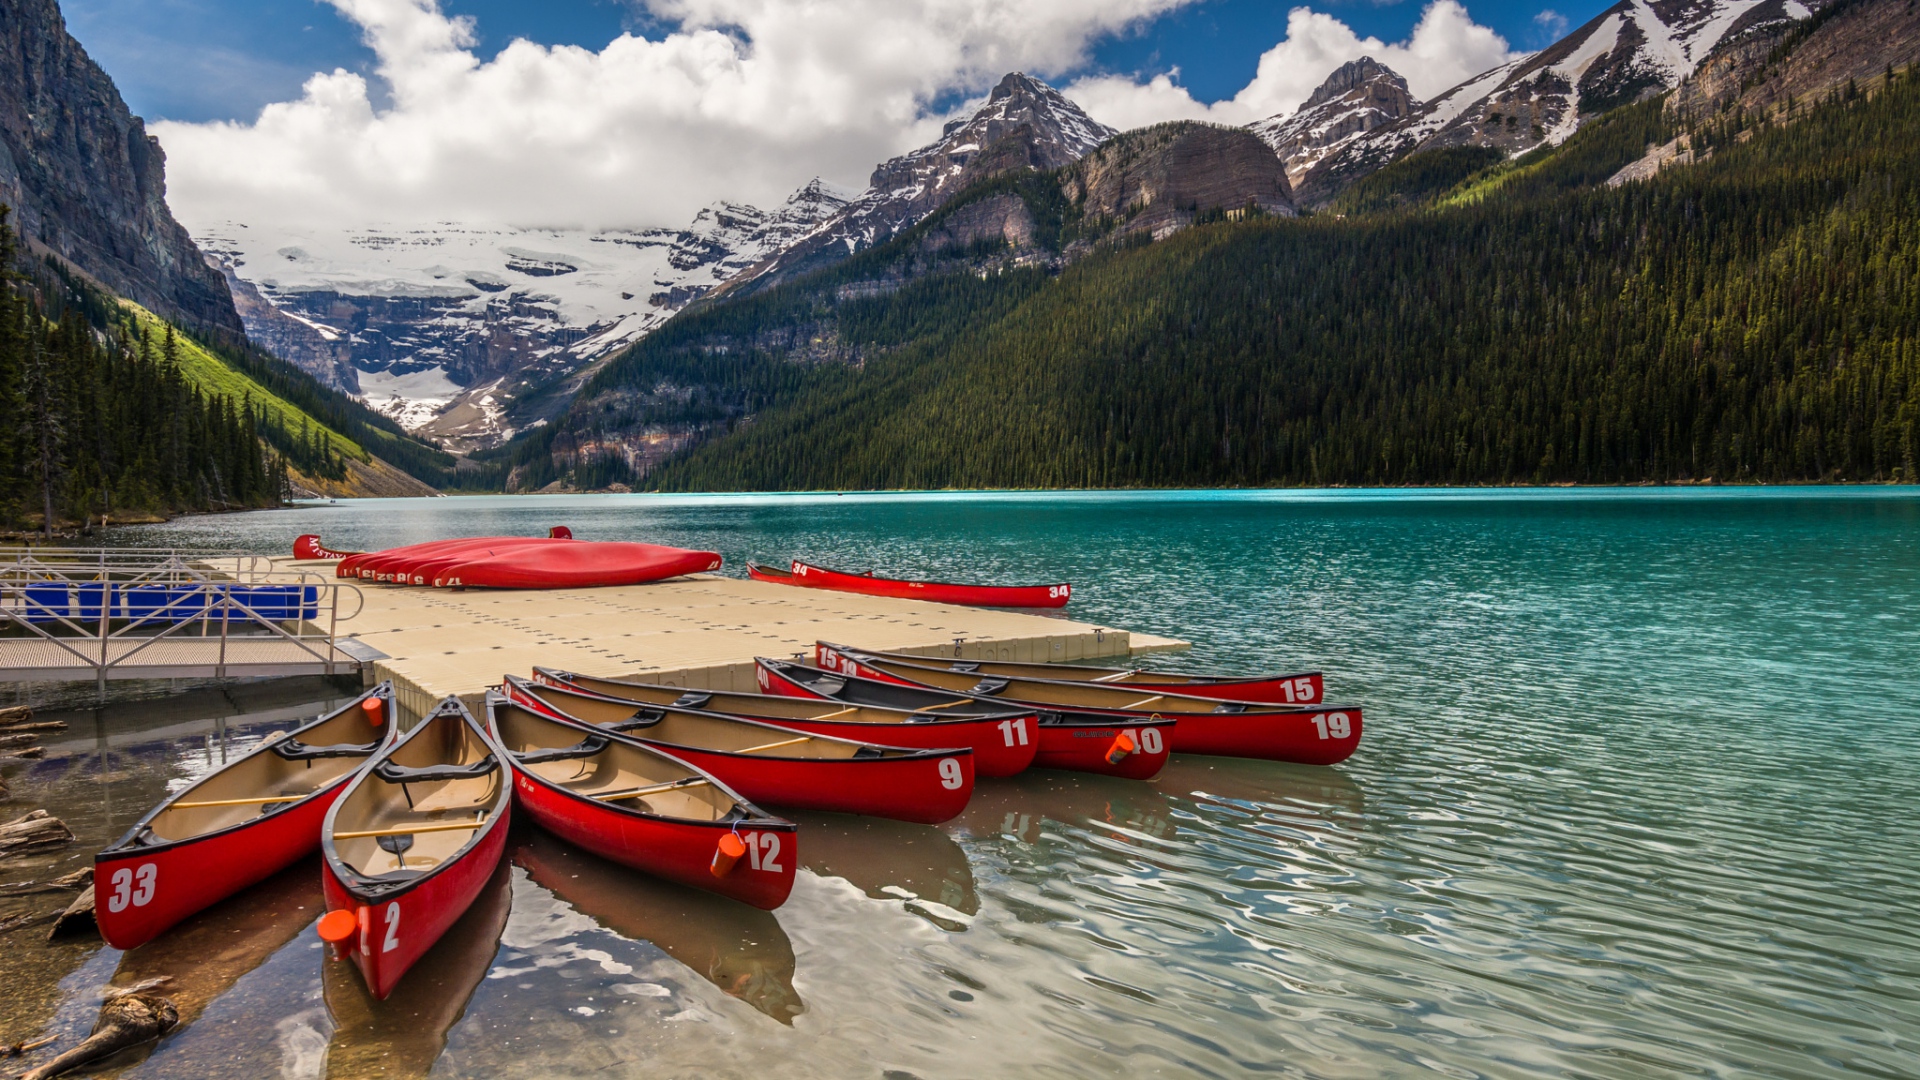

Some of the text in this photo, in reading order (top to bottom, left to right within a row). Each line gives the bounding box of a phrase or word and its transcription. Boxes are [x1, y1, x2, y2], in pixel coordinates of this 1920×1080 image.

[414, 575, 424, 585] 5
[446, 577, 462, 586] 17
[793, 562, 808, 577] 34
[1049, 585, 1069, 598] 34
[819, 647, 837, 669] 15
[840, 658, 857, 677] 19
[757, 665, 769, 689] 40
[1280, 678, 1315, 703] 15
[997, 718, 1029, 747] 11
[1311, 712, 1351, 740] 19
[1121, 727, 1163, 755] 40
[937, 757, 964, 791] 9
[744, 831, 783, 873] 12
[108, 862, 158, 913] 33
[382, 901, 400, 954] 2
